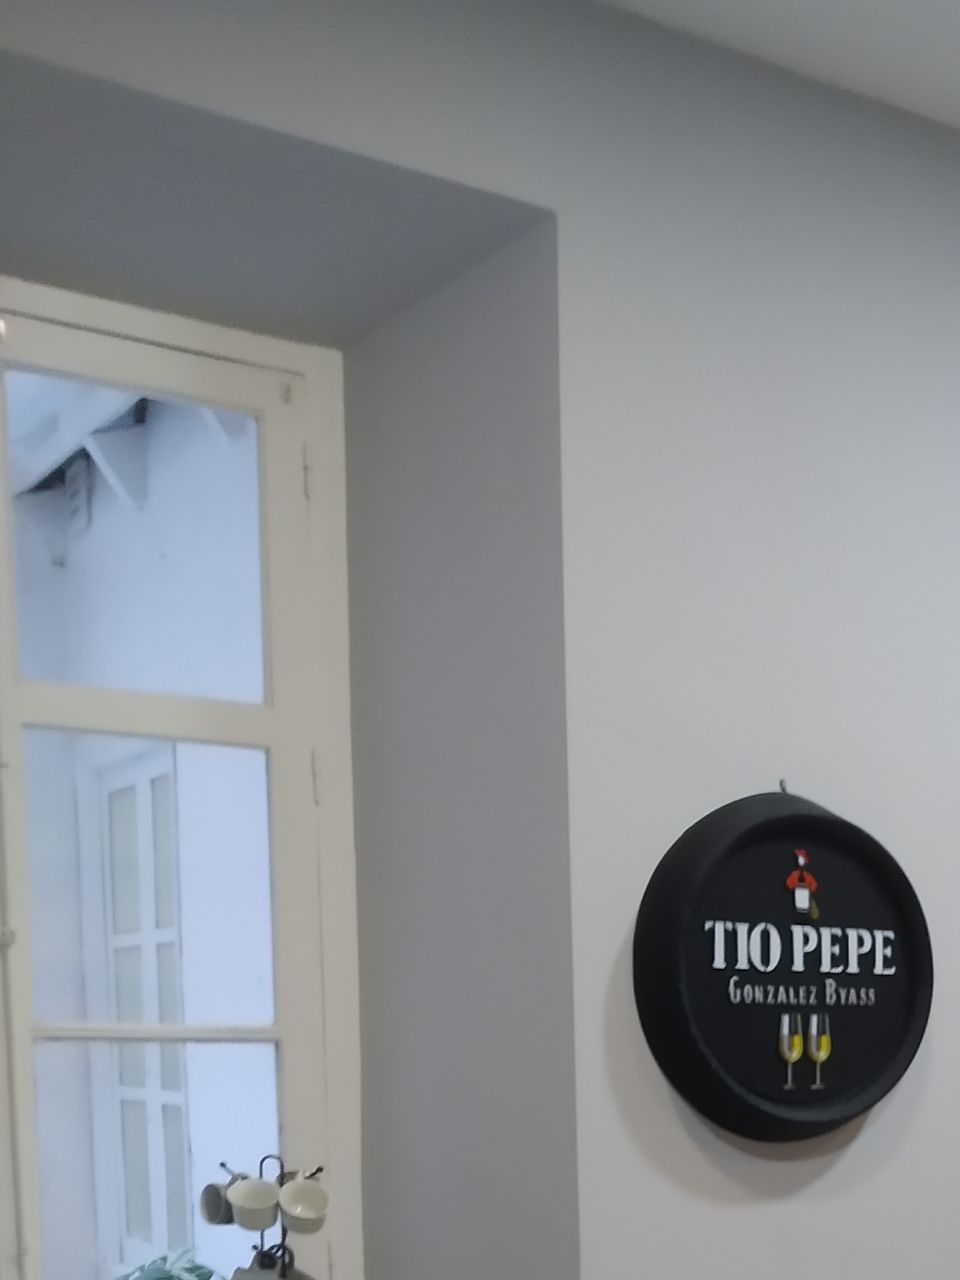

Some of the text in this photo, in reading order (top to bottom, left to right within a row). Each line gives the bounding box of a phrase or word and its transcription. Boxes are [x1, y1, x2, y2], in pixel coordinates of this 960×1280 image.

[704, 920, 896, 975] TIO PEPE
[728, 975, 876, 1006] GONZALEZ BYASS
